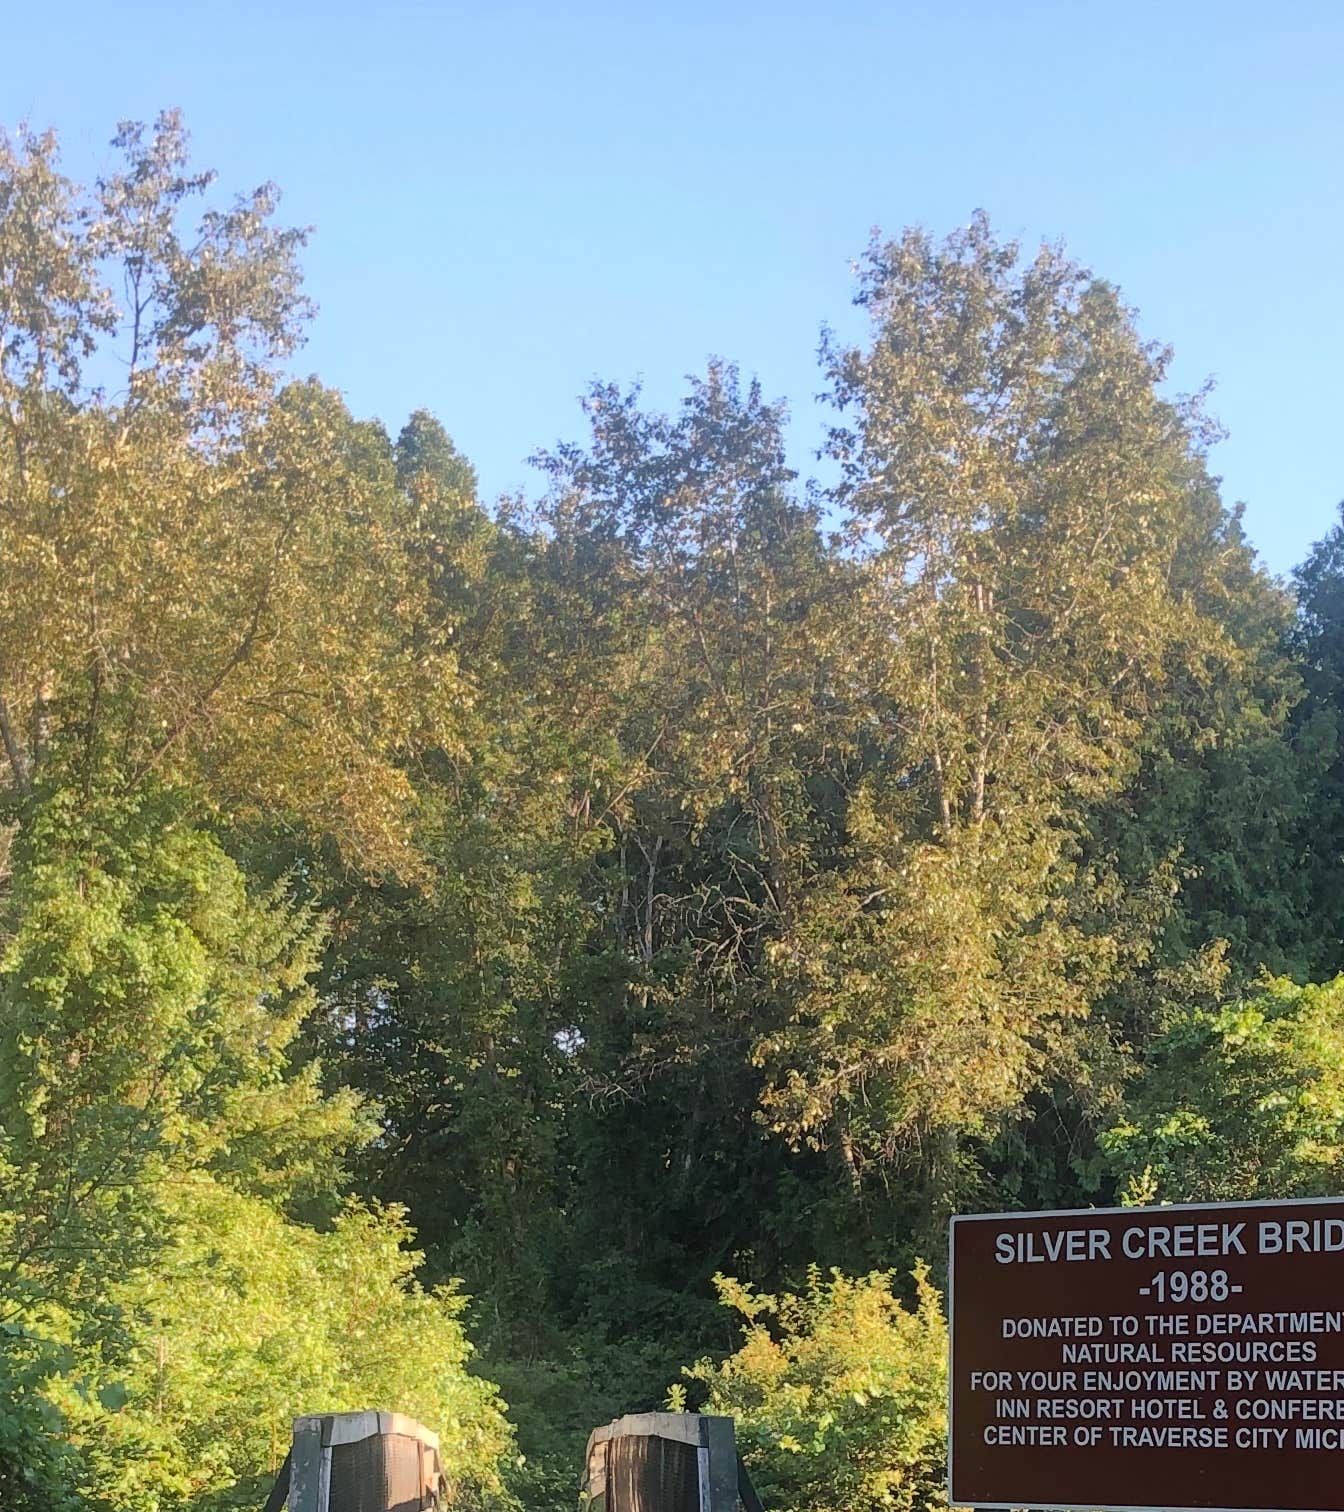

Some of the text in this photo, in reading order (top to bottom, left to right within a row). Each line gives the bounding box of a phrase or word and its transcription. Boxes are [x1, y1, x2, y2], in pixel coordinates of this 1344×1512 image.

[995, 1229, 1112, 1264] SILVER
[1122, 1222, 1247, 1259] CREEK
[1139, 1269, 1243, 1303] -1988-
[1002, 1316, 1103, 1338] DONATED
[1108, 1315, 1139, 1336] TO
[1144, 1314, 1189, 1336] THE
[1062, 1341, 1317, 1364] NATURAL RESOURCES
[971, 1371, 1013, 1391] FOR
[1016, 1371, 1078, 1391] YOUR
[1083, 1370, 1221, 1391] ENJOYMENT
[1227, 1370, 1259, 1391] BY
[996, 1398, 1030, 1418] INN
[1037, 1398, 1125, 1419] RESORT
[1131, 1398, 1206, 1419] HOTEL
[1212, 1398, 1229, 1420] &
[983, 1425, 1068, 1446] CENTER
[1073, 1426, 1103, 1446] OF
[1108, 1426, 1229, 1448] TRAVERSE
[1235, 1427, 1289, 1449] CITY
